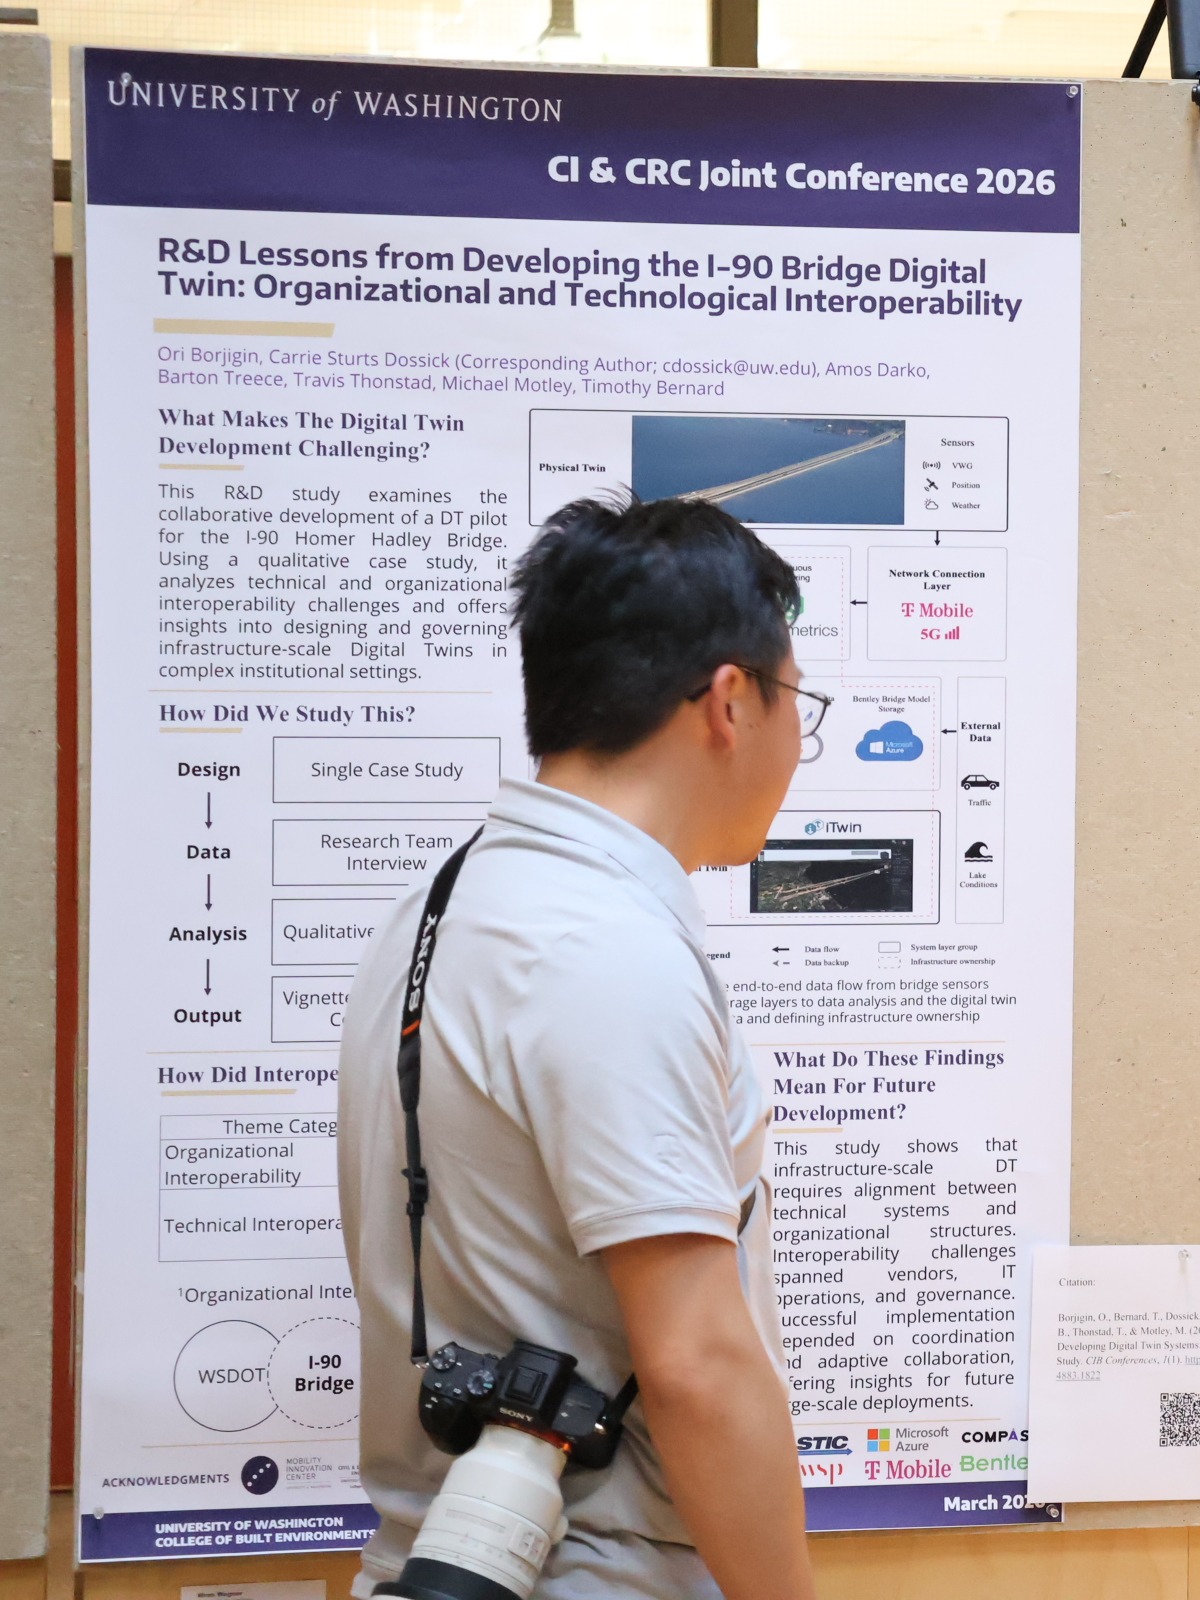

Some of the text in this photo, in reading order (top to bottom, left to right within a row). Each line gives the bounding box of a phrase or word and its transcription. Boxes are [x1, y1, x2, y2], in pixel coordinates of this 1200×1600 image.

[107, 79, 562, 122] UNIVERSITY of WASHINGTON
[548, 155, 1055, 195] CI & CRC Joint Conference 2026
[159, 237, 985, 289] R&D Lessons from Developing the I-90 Bridge Digital
[157, 270, 1022, 322] Twin: Organizational and Technological Interoperability
[158, 368, 724, 398] Barton Treece, Travis Thonstad, Michael Motley, Timothy Bernard
[158, 408, 463, 434] What Makes The Digital Twin
[159, 436, 429, 462] Development Challenging?
[940, 438, 975, 446] Sensors
[539, 463, 606, 473] Physical Twin
[951, 501, 980, 509] Weather
[889, 569, 985, 578] Network Connection
[923, 581, 951, 592] Layer
[919, 602, 973, 617] Mobile
[920, 626, 941, 641] 5G
[160, 704, 415, 726] How Did We Study This?
[961, 721, 1002, 731] External
[969, 733, 991, 742] Data
[178, 761, 240, 781] Design
[311, 761, 463, 781] Single Case Study
[321, 833, 452, 848] Research Team
[187, 844, 230, 859] Data
[347, 855, 427, 870] Interview
[969, 871, 987, 880] Lake
[959, 881, 998, 889] Conditions
[169, 926, 247, 945] Analysis
[408, 912, 438, 1012] SONY
[174, 1008, 241, 1027] Output
[773, 1048, 1004, 1068] What Do These Findings
[774, 1077, 935, 1094] Mean For Future
[773, 1102, 907, 1126] Development?
[773, 1136, 1017, 1158] This study shows that
[1058, 1278, 1095, 1286] Citation:
[1057, 1341, 1106, 1353] Developing
[1108, 1340, 1137, 1352] Digital
[1141, 1341, 1161, 1349] Twin
[309, 1354, 341, 1369] I-90
[197, 1367, 266, 1385] WSDOT
[295, 1375, 354, 1394] Bridge
[499, 1407, 534, 1422] SONY
[895, 1426, 950, 1439] Microsoft
[895, 1440, 930, 1452] Azure
[886, 1458, 951, 1479] Mobile
[102, 1473, 229, 1487] ACKNOWLEDGMENTS
[155, 1516, 343, 1534] UNIVERSITY OF WASHINGTON
